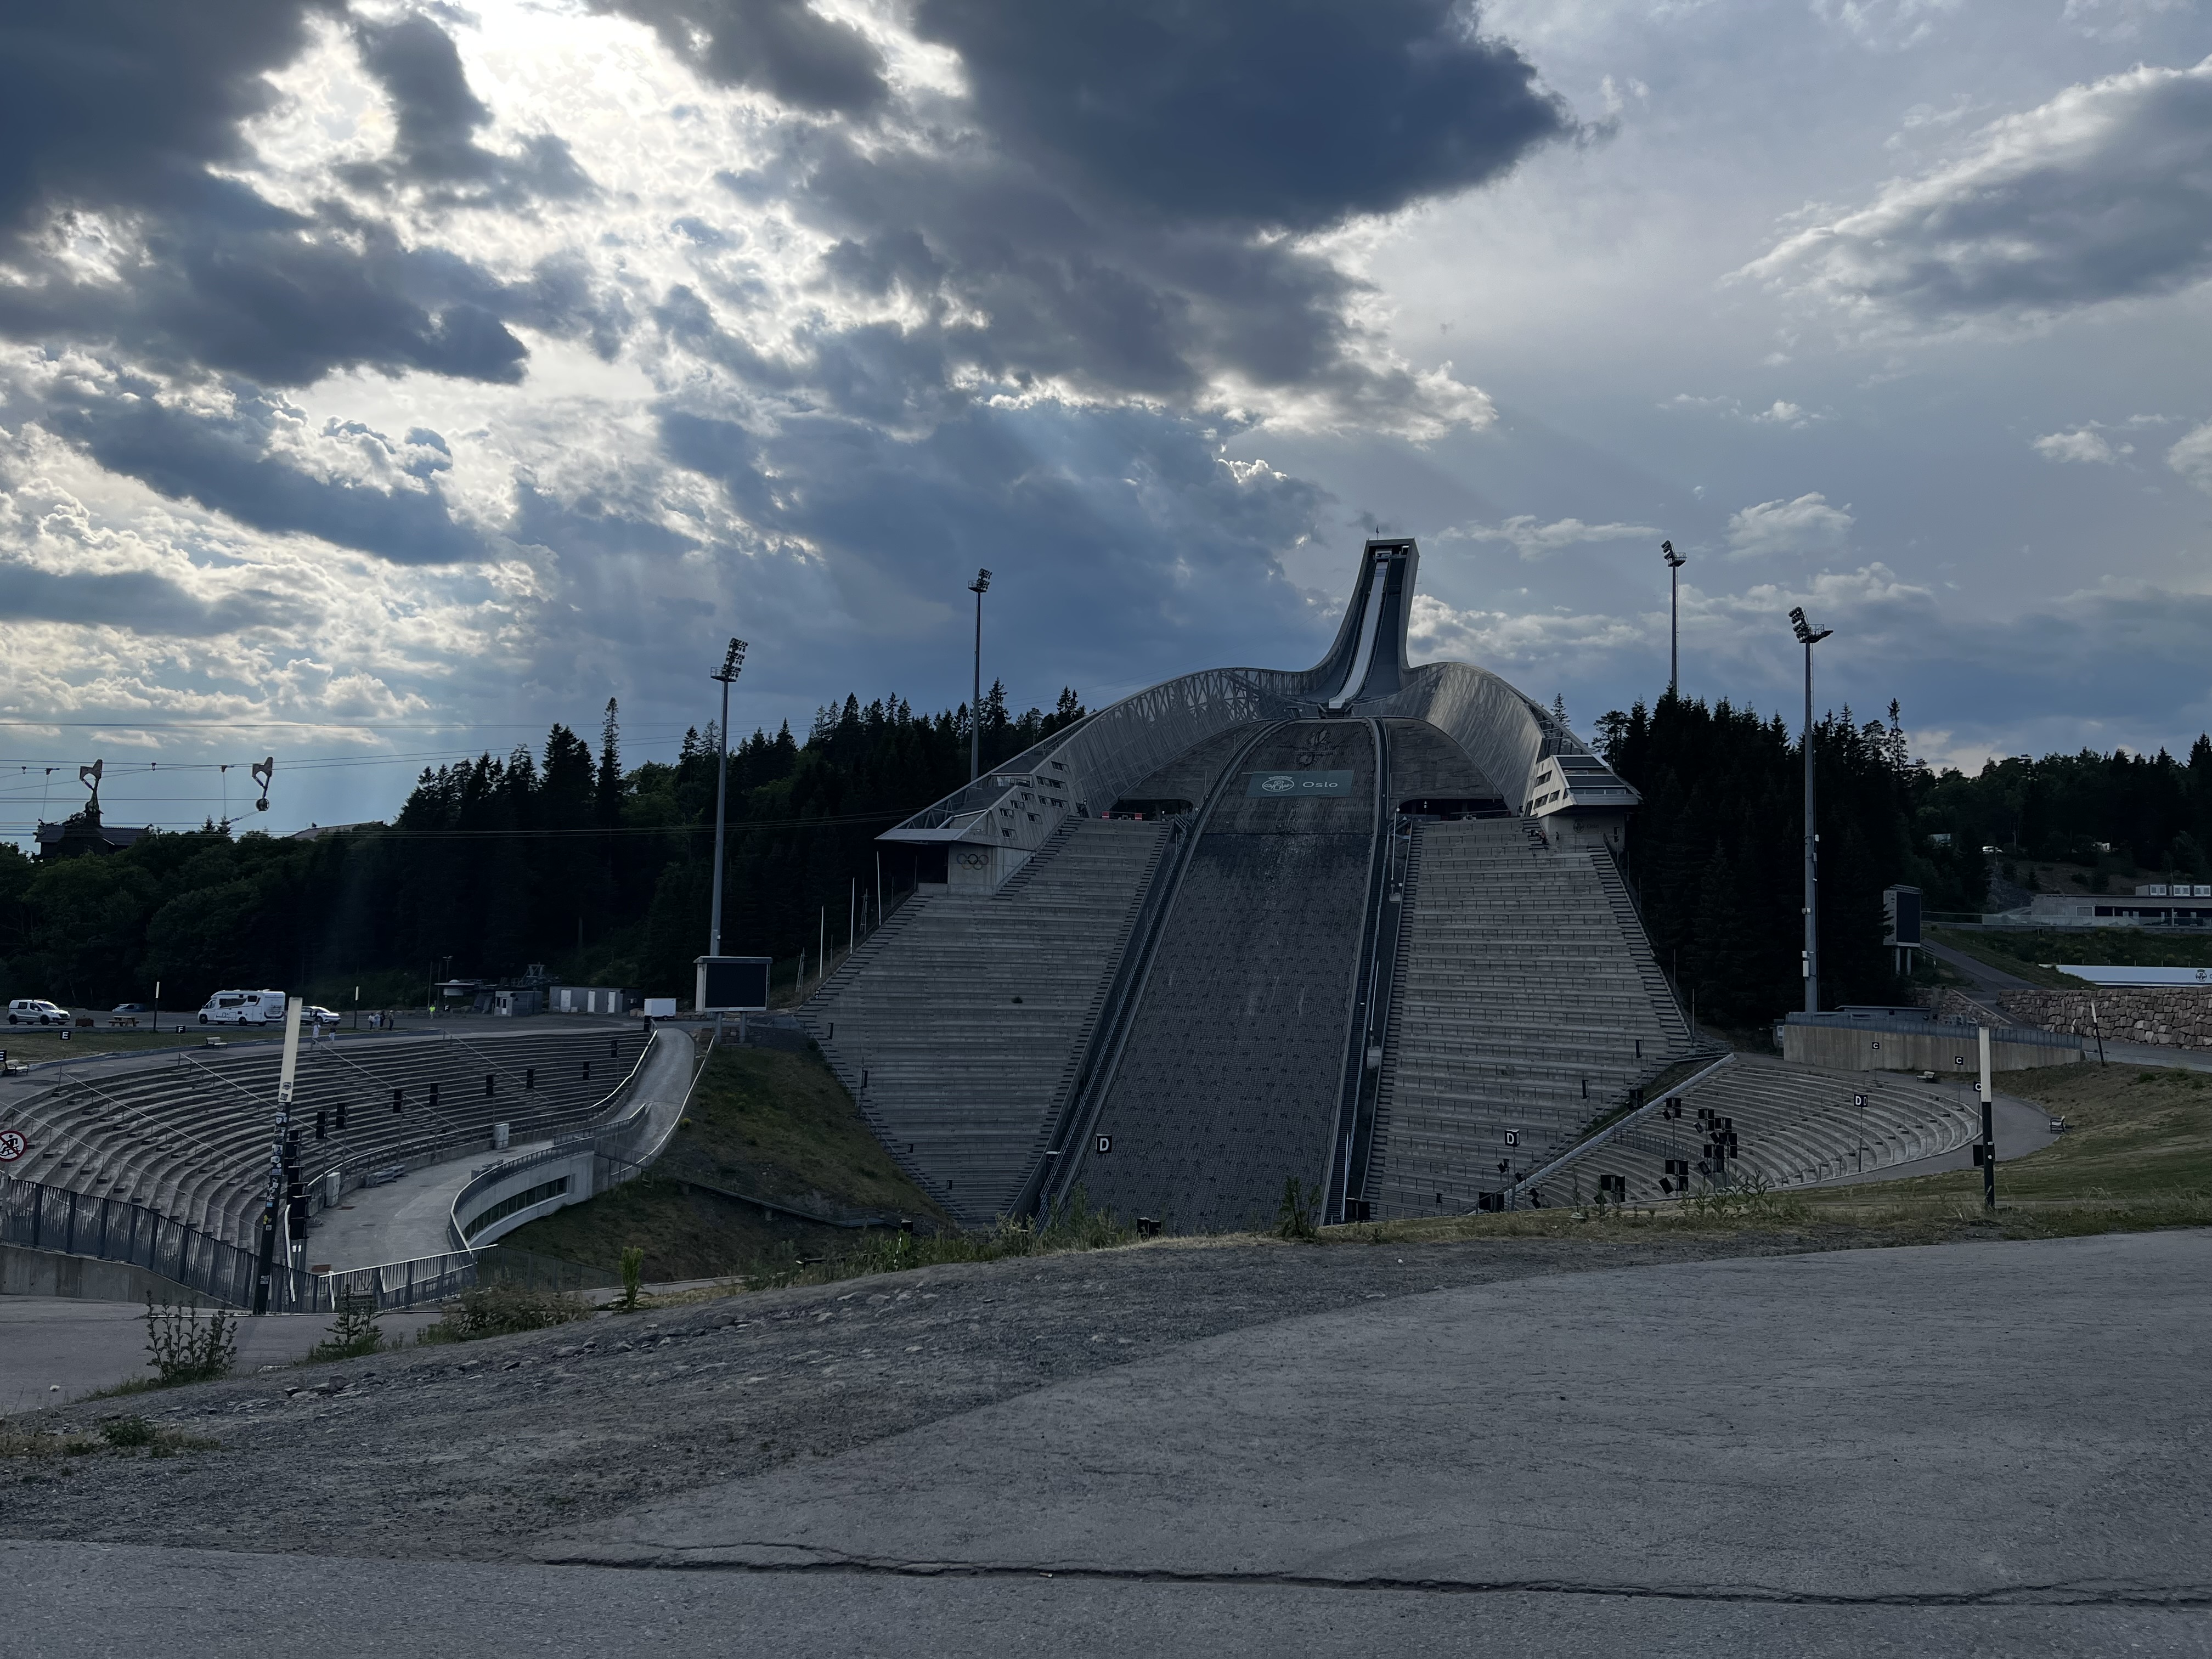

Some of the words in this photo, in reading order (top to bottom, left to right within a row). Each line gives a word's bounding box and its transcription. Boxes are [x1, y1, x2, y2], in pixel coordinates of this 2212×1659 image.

[1855, 1096, 1861, 1105] D
[1506, 1133, 1514, 1144] D
[1100, 1138, 1109, 1151] D
